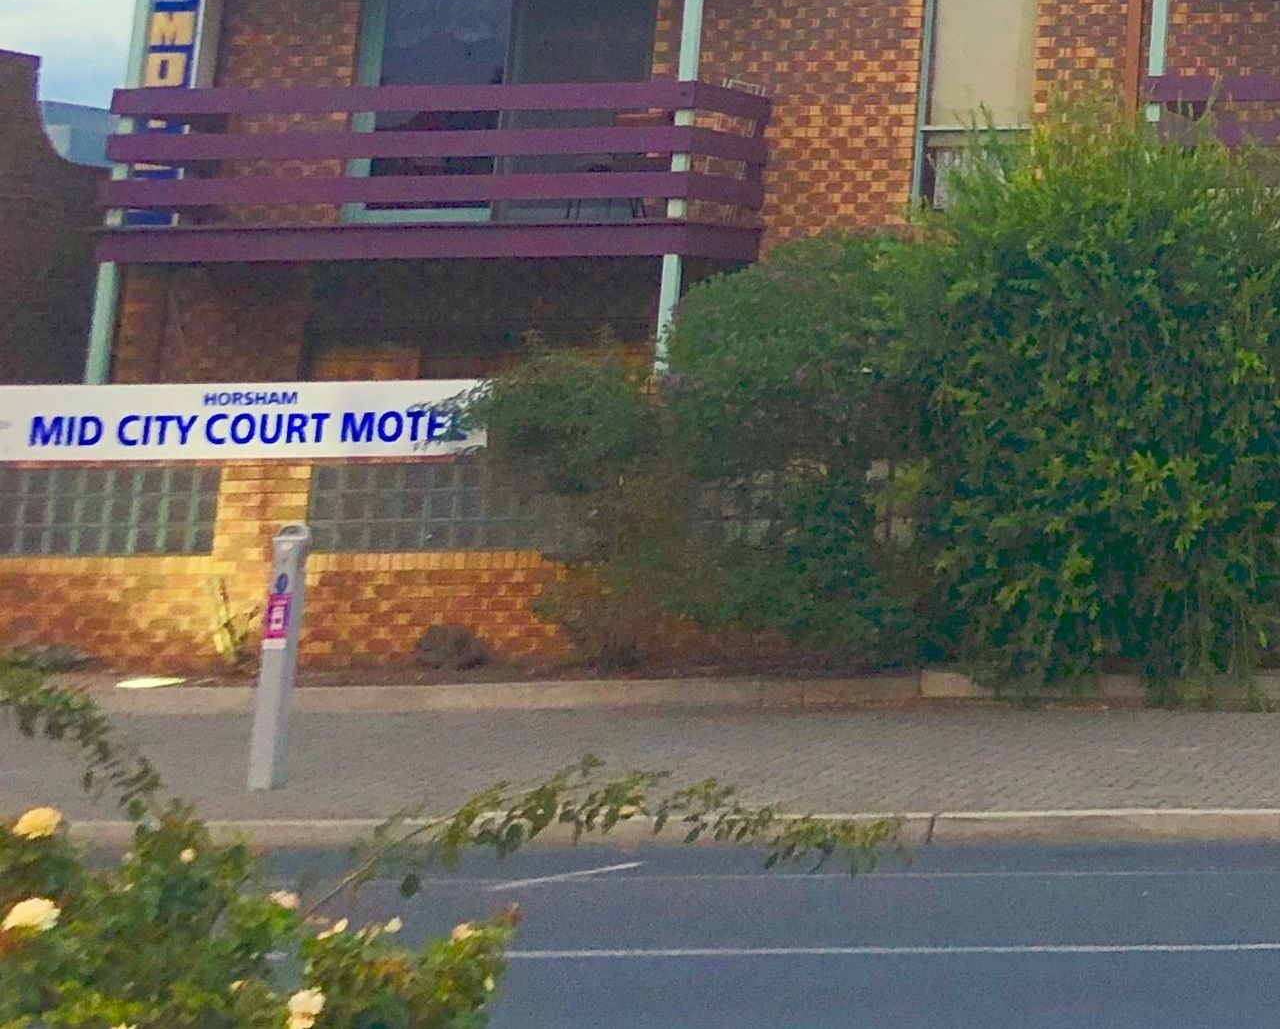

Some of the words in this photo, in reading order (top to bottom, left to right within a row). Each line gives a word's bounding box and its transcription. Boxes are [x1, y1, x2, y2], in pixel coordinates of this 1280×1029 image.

[203, 391, 299, 407] HORSHAM
[29, 415, 104, 447] MID
[117, 414, 199, 446] CITY
[205, 411, 331, 445] COURT
